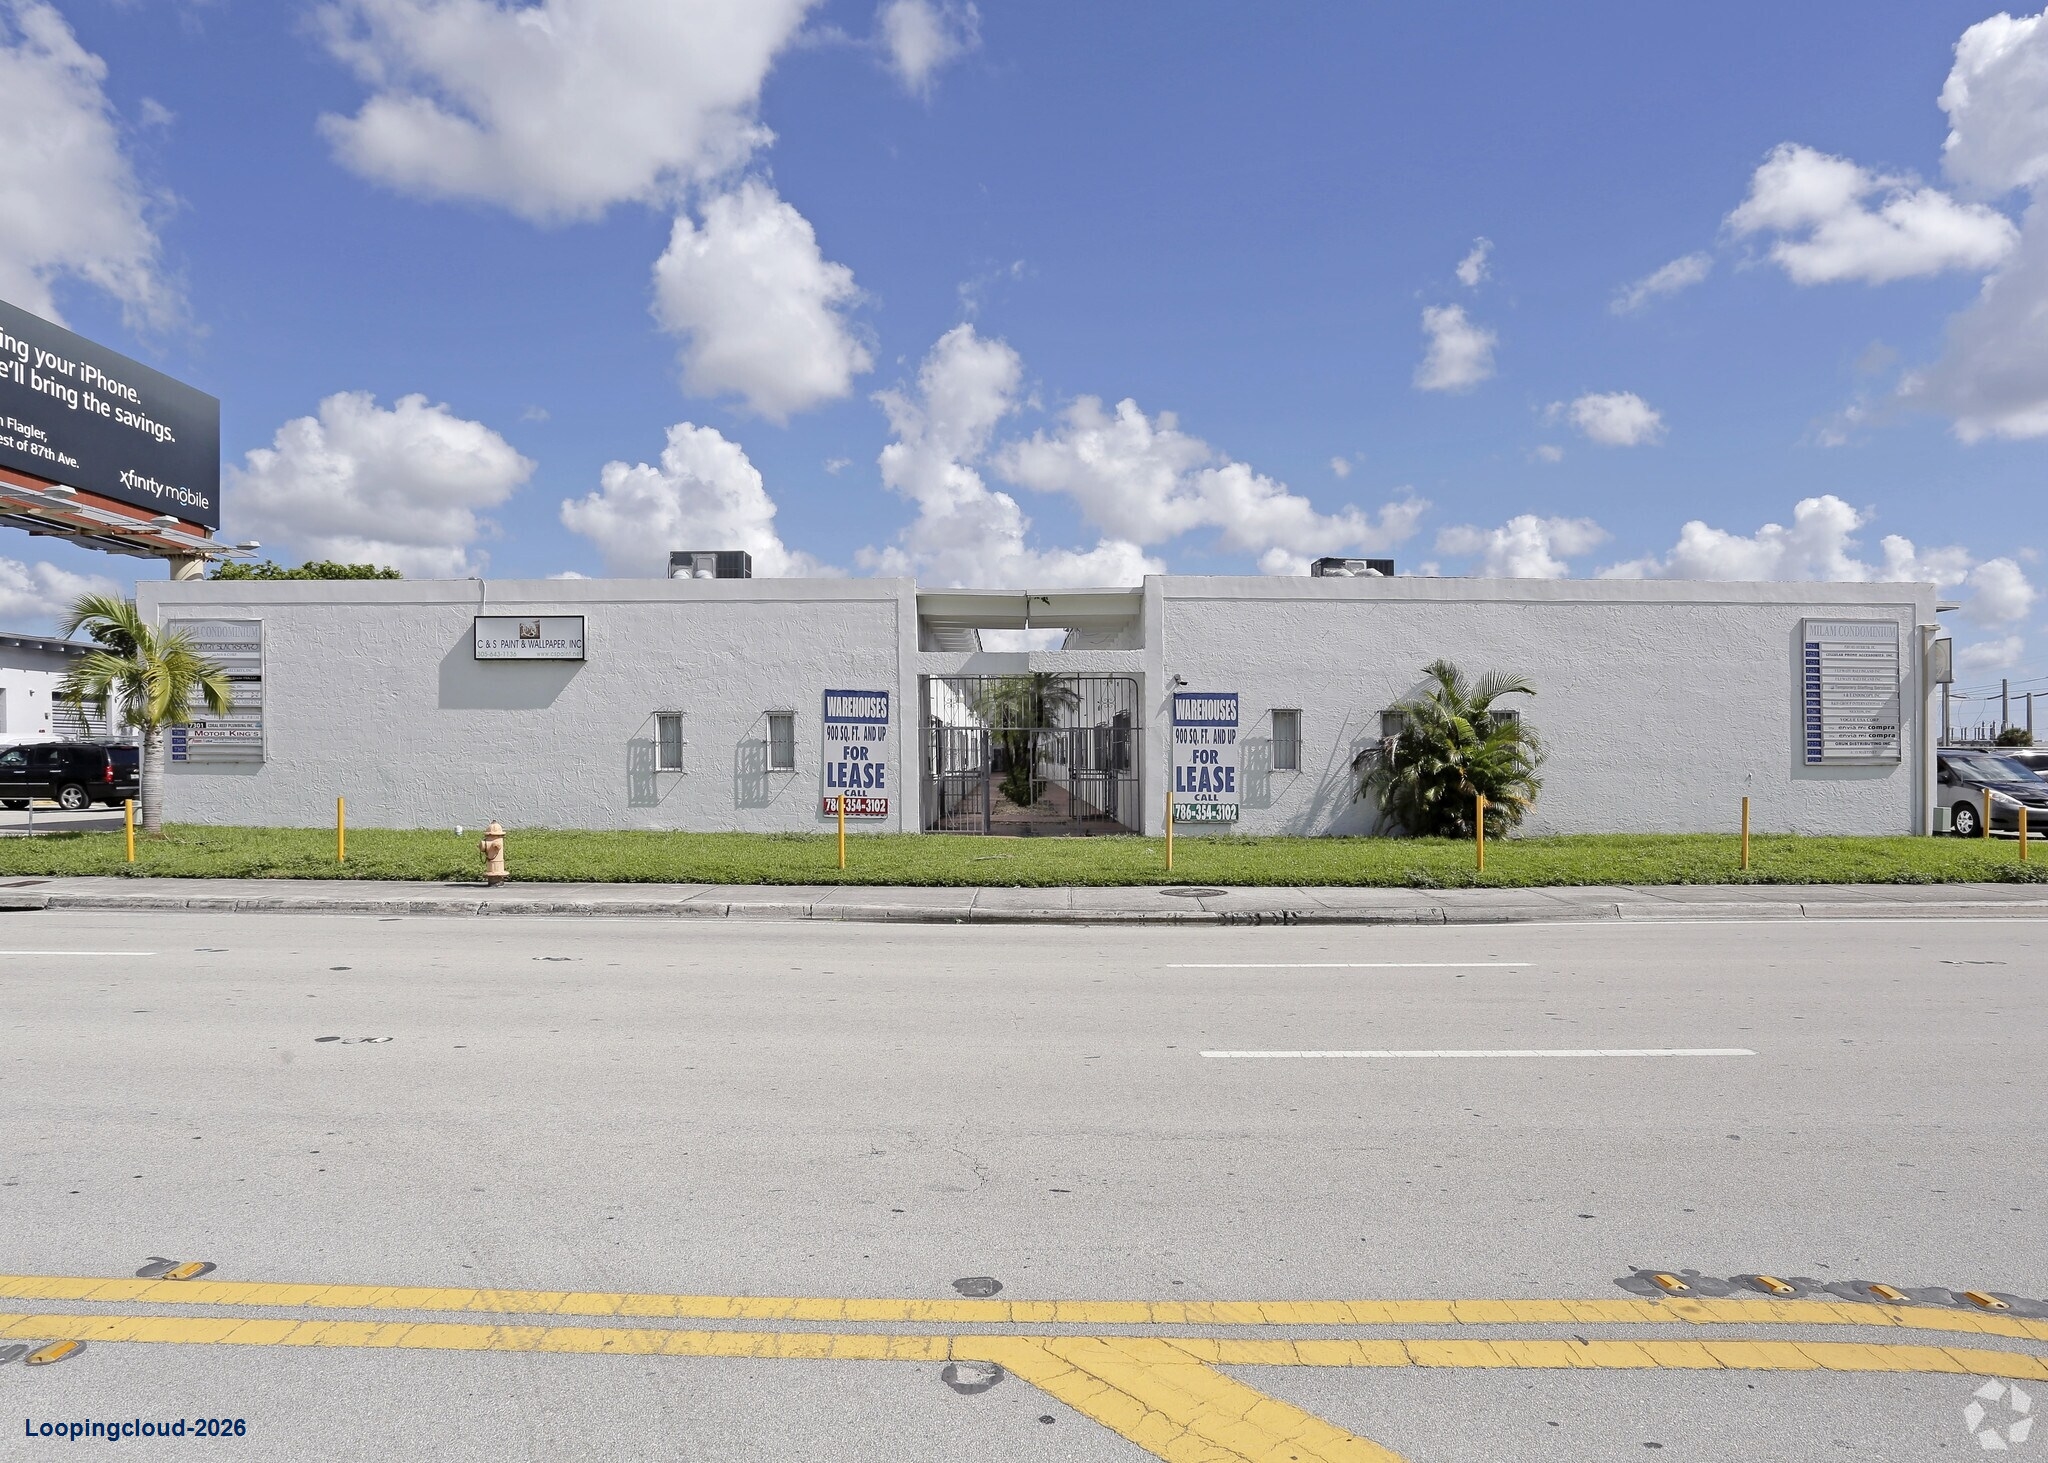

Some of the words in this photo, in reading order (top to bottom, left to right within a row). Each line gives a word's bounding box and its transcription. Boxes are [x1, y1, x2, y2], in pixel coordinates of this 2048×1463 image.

[34, 347, 76, 377] your
[80, 361, 141, 404] iPhone.
[30, 368, 78, 410] bring
[83, 391, 111, 417] the
[115, 407, 176, 443] savings.
[7, 416, 48, 443] Flagler,
[16, 439, 29, 451] of
[30, 443, 55, 461] 87th
[58, 452, 80, 469] Ave.
[120, 469, 164, 498] xfinity
[165, 486, 210, 510] mobile
[1809, 624, 1837, 637] MILAM
[1839, 625, 1896, 638] CONDOMINIUM
[477, 639, 484, 649] C
[485, 639, 491, 649] &
[492, 639, 497, 649] S
[500, 639, 520, 649] PAINT
[520, 639, 526, 649] &
[527, 639, 568, 650] WALLPAPER,
[826, 696, 887, 718] WAREHOUSES
[1175, 699, 1237, 721] WAREHOUSES
[826, 725, 839, 741] 900
[840, 725, 851, 743] SQ.
[851, 725, 860, 741] FT.
[863, 726, 877, 742] AND
[877, 726, 887, 742] UP
[1175, 728, 1188, 744] 900
[1189, 728, 1200, 746] SQ.
[1200, 728, 1210, 745] FT.
[1212, 728, 1226, 745] AND
[1227, 728, 1237, 745] UP
[843, 745, 869, 761] FOR
[1192, 749, 1219, 764] FOR
[827, 762, 885, 789] LEASE
[1176, 766, 1235, 793] LEASE
[844, 789, 868, 797] CALL
[1194, 794, 1218, 802] CALL
[1175, 804, 1237, 820] 786-354-3102
